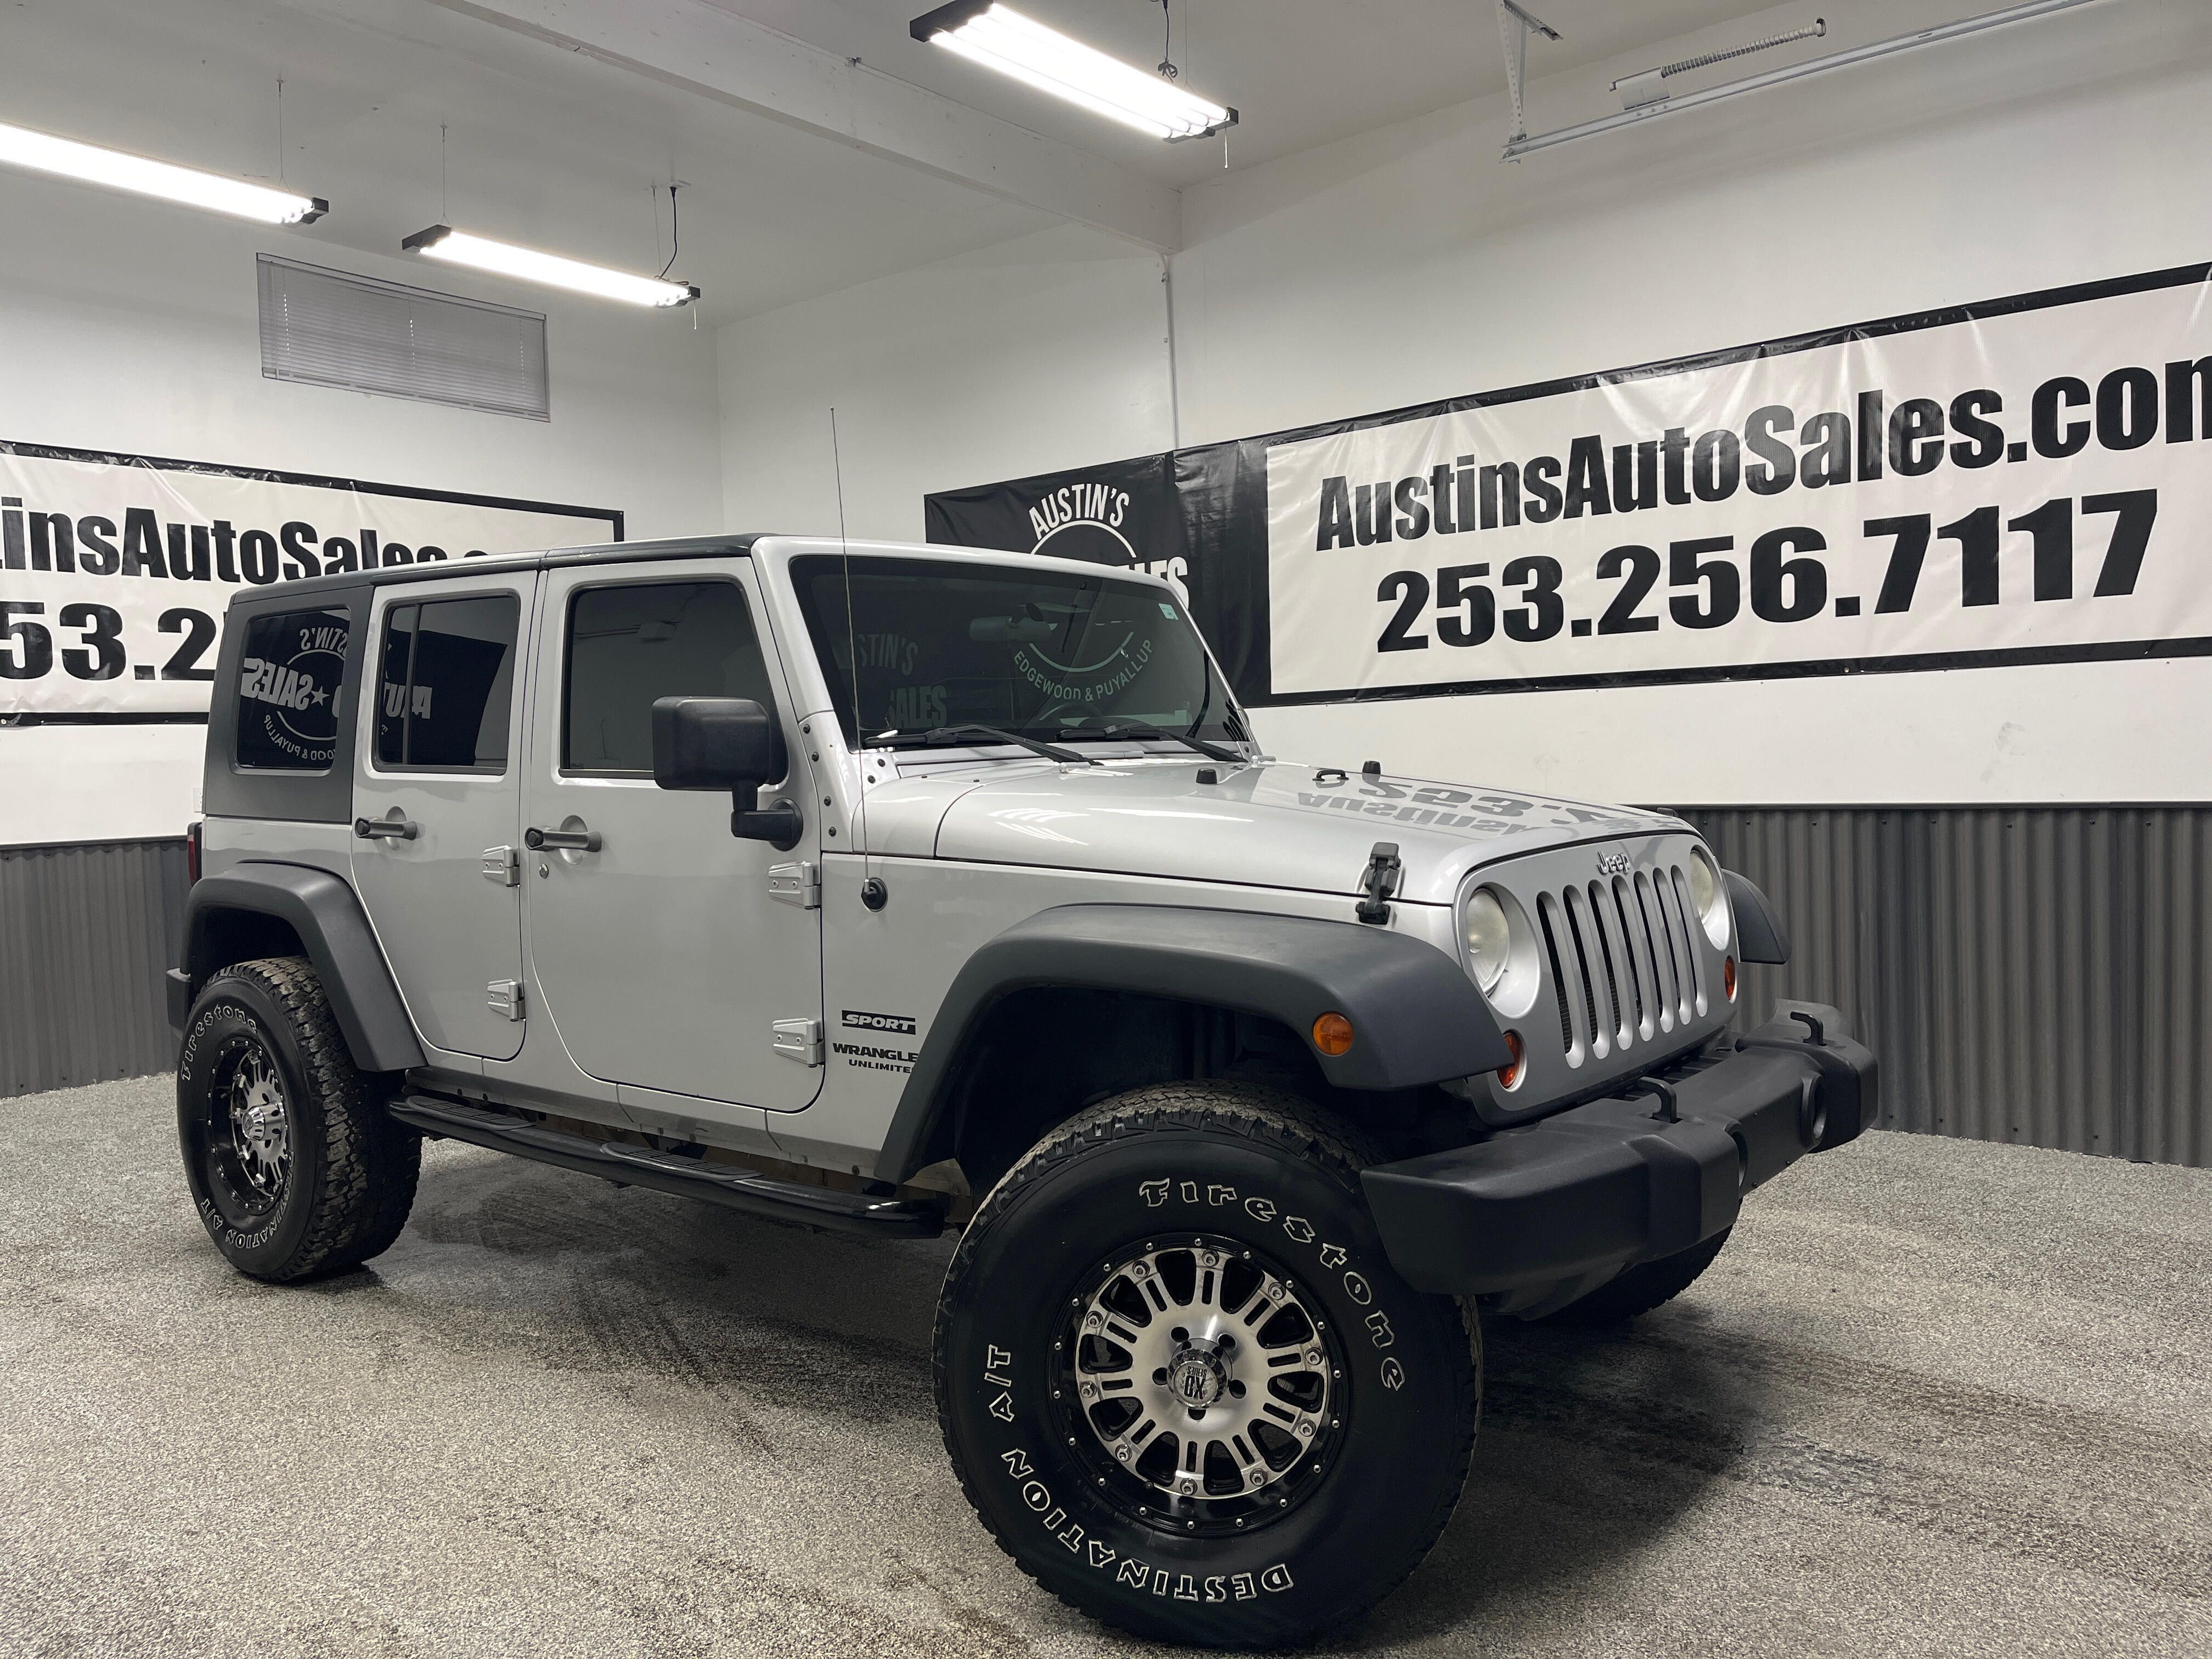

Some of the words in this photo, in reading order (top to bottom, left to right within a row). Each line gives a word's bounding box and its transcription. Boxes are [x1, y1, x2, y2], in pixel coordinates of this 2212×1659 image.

[1029, 483, 1129, 540] AUSTIN'S
[1376, 488, 2157, 652] 253.256.7117
[0, 601, 228, 681] 53.2
[1014, 651, 1081, 700] EDGEWOOD
[1085, 687, 1093, 701] &
[1096, 639, 1152, 699] PUYALLUP
[1597, 851, 1630, 875] Jeep
[180, 1004, 257, 1081] Firestone
[832, 1043, 919, 1063] WRANGLE
[844, 1013, 912, 1032] SPORT
[848, 1059, 914, 1074] UNLIMITE
[200, 1198, 223, 1231] A/T
[1139, 1177, 1406, 1392] Firestone
[984, 1344, 1014, 1422] A/T
[1001, 1448, 1294, 1602] DESTINATION
